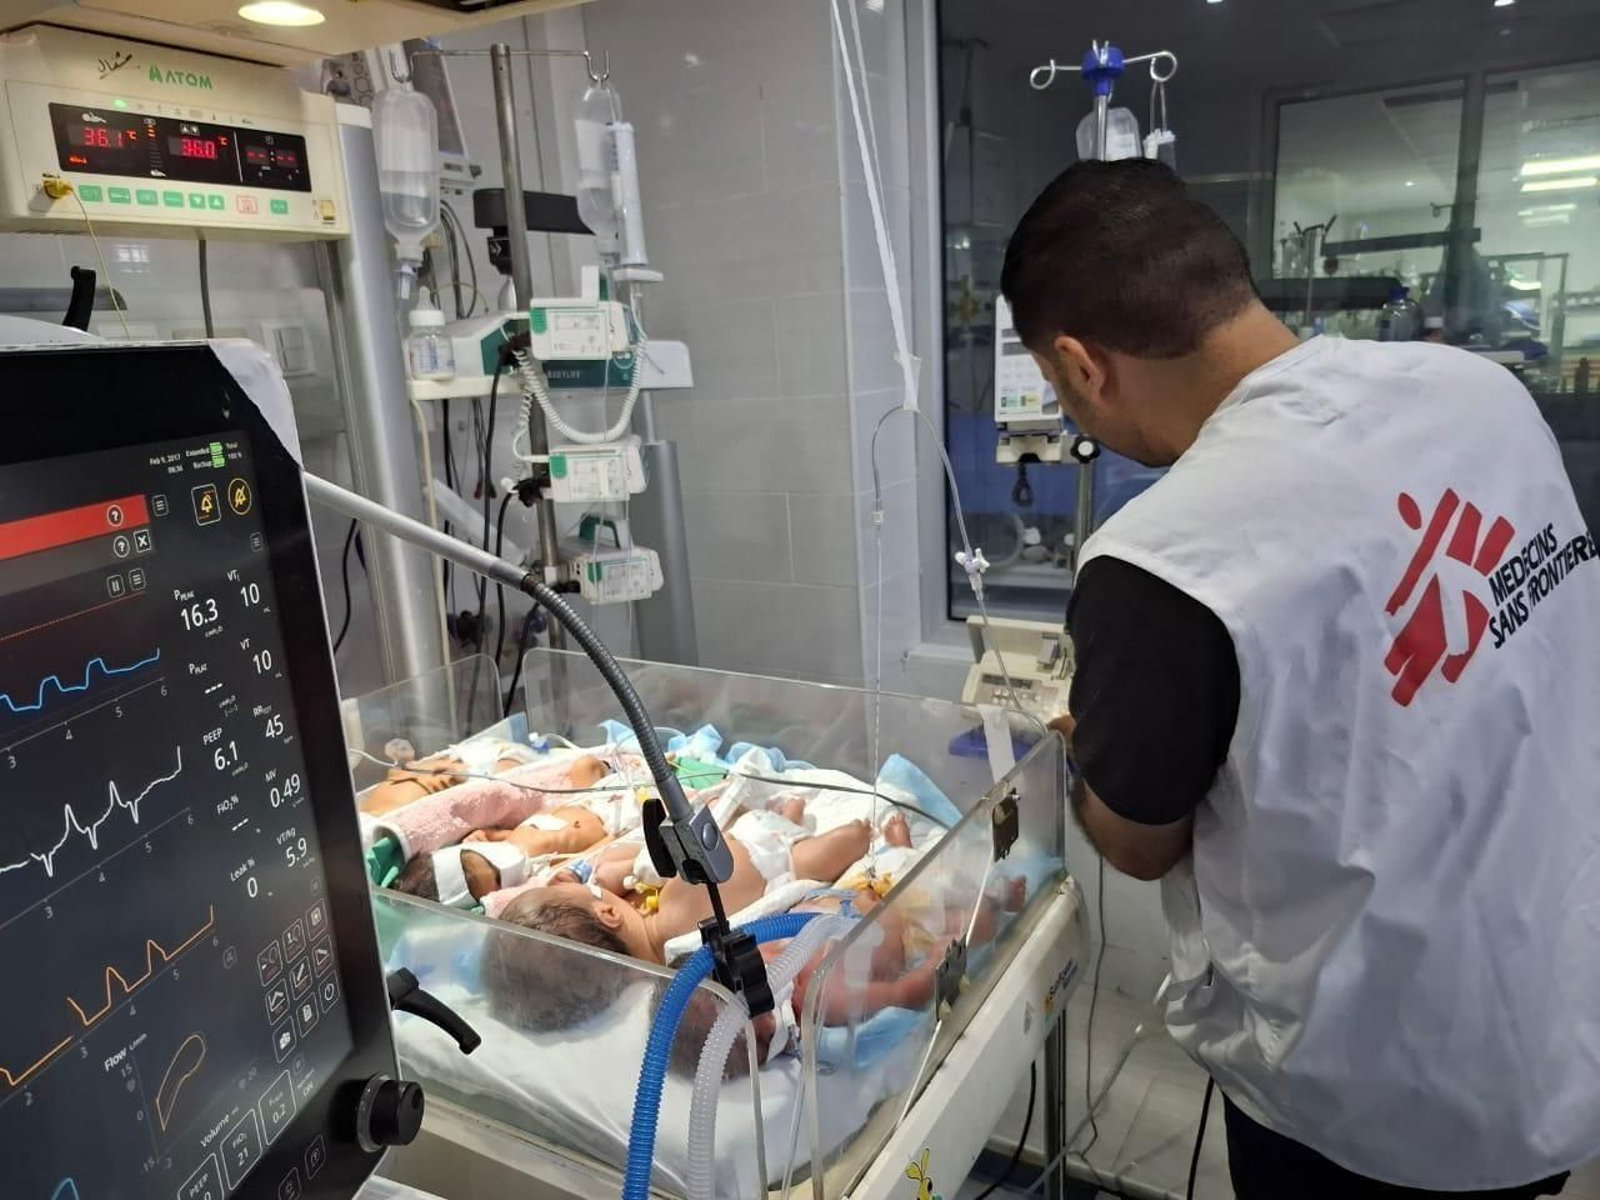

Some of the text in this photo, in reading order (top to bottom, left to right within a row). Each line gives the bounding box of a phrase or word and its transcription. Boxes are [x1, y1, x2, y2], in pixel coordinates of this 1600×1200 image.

[166, 69, 213, 91] ATOM
[1488, 523, 1557, 607] MEDECINS
[240, 583, 260, 607] 10
[180, 598, 219, 631] 16.3
[1489, 590, 1529, 650] SANS
[253, 649, 272, 674] 10
[7, 686, 168, 769] 3 4 5 6
[203, 727, 222, 746] PEEP
[265, 714, 284, 738] 45
[214, 740, 238, 771] 6.1
[270, 773, 301, 808] 0.49
[44, 814, 194, 919] 3 4 5 6
[285, 837, 307, 868] 5.9
[230, 863, 248, 882] Leak
[247, 877, 258, 898] 0
[80, 1046, 89, 1059] 3
[173, 969, 180, 981] 5
[104, 1047, 127, 1072] Flow
[200, 1113, 230, 1148] Volume
[238, 1147, 249, 1167] 21
